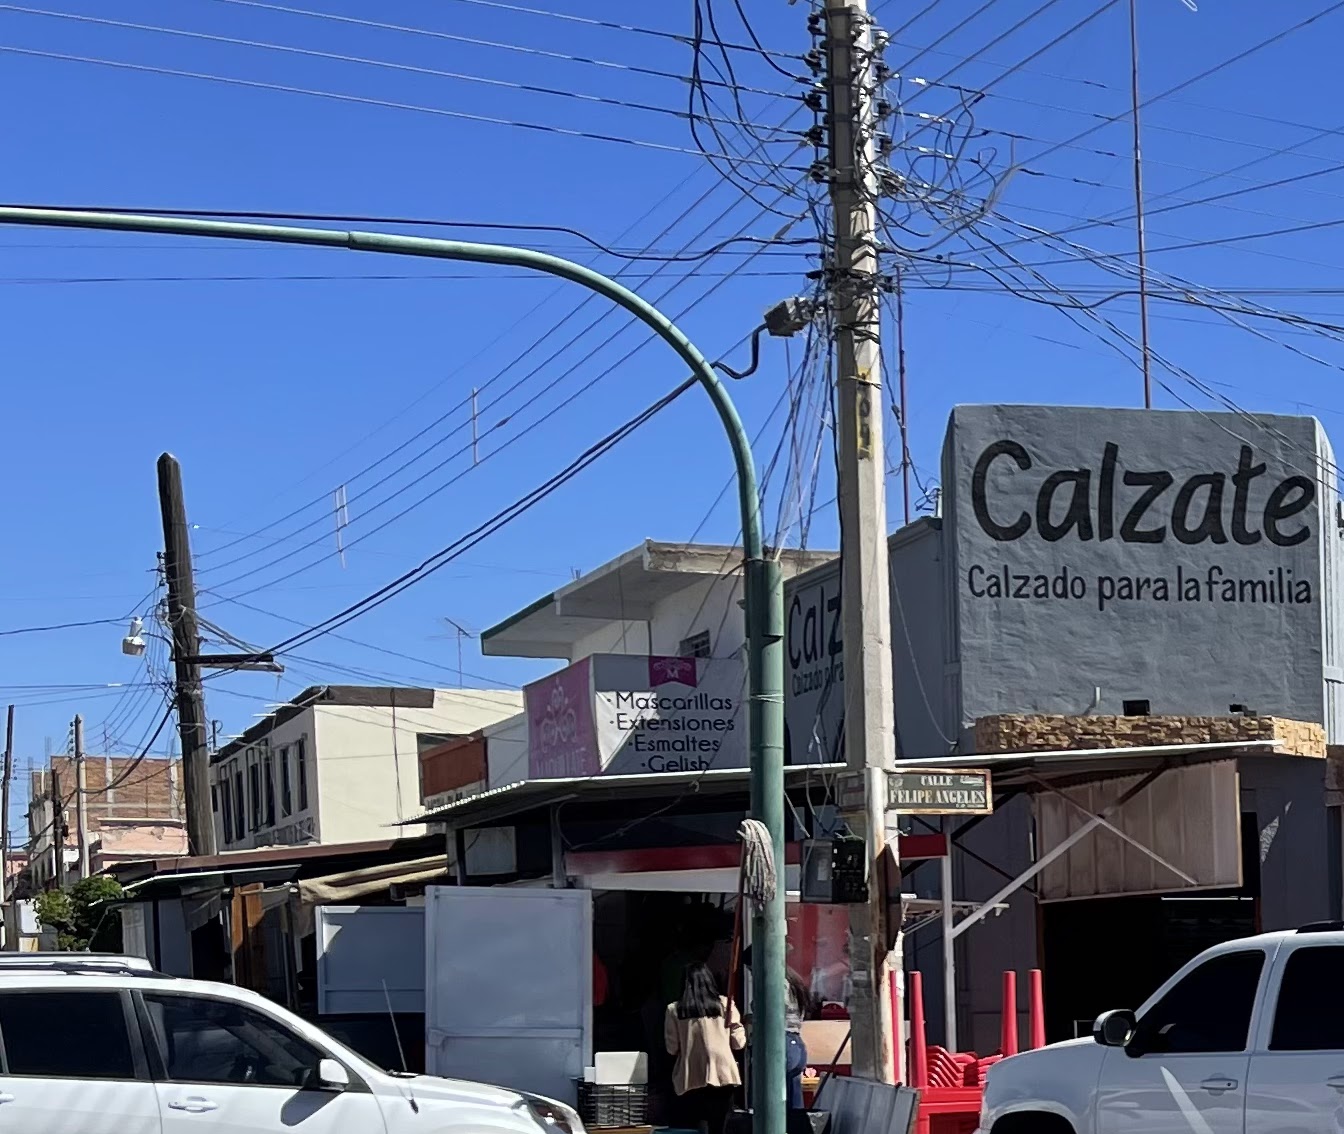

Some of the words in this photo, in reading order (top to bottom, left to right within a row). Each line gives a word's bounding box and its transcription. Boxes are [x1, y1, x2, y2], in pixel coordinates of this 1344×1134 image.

[972, 439, 1316, 547] Calzate
[968, 564, 1087, 600] Calzado
[1100, 575, 1169, 611] para
[1205, 565, 1312, 604] familia
[788, 585, 843, 669] Calz
[616, 690, 733, 711] Mascarillas
[617, 712, 735, 732] Extensiones
[634, 733, 720, 752] Esmaltes
[647, 754, 710, 772] Gelish
[920, 775, 954, 786] CALLE
[890, 789, 933, 804] FELIPE
[935, 789, 986, 804] ANGELES
